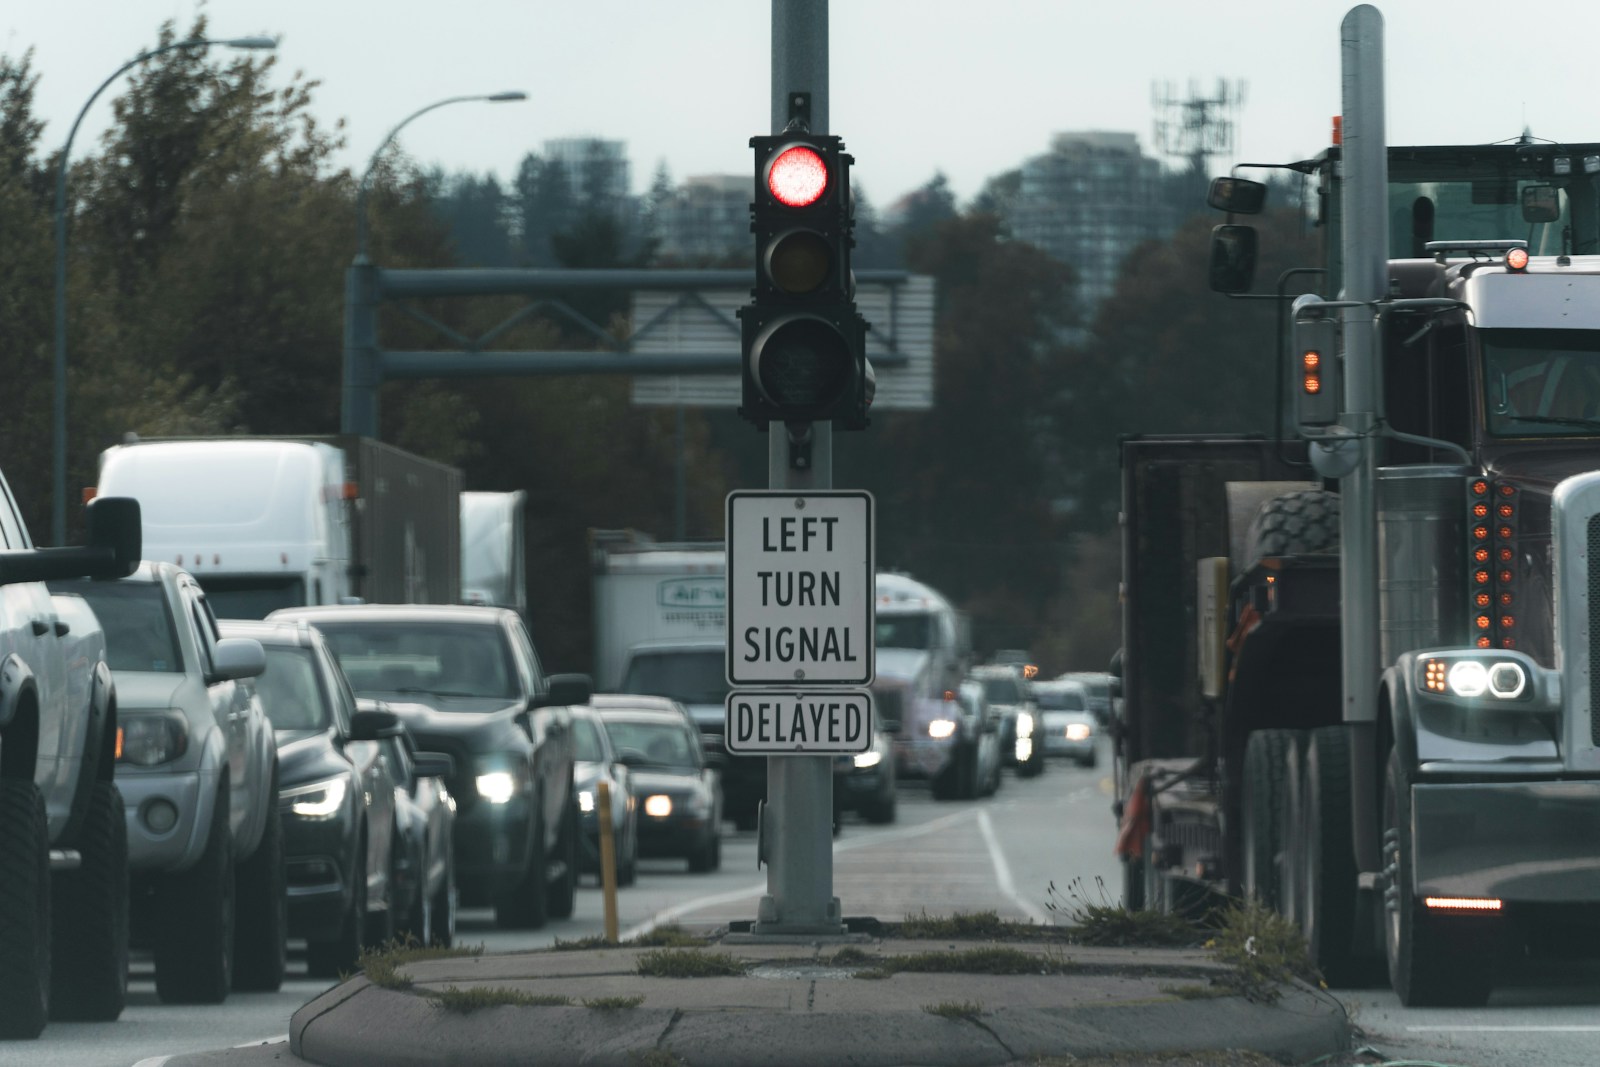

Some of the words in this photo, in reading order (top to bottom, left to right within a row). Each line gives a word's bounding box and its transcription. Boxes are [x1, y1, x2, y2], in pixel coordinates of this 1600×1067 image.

[762, 516, 839, 552] LEFT
[757, 571, 840, 606] TURN
[744, 627, 857, 662] SIGNAL
[737, 703, 861, 742] DELAYED
